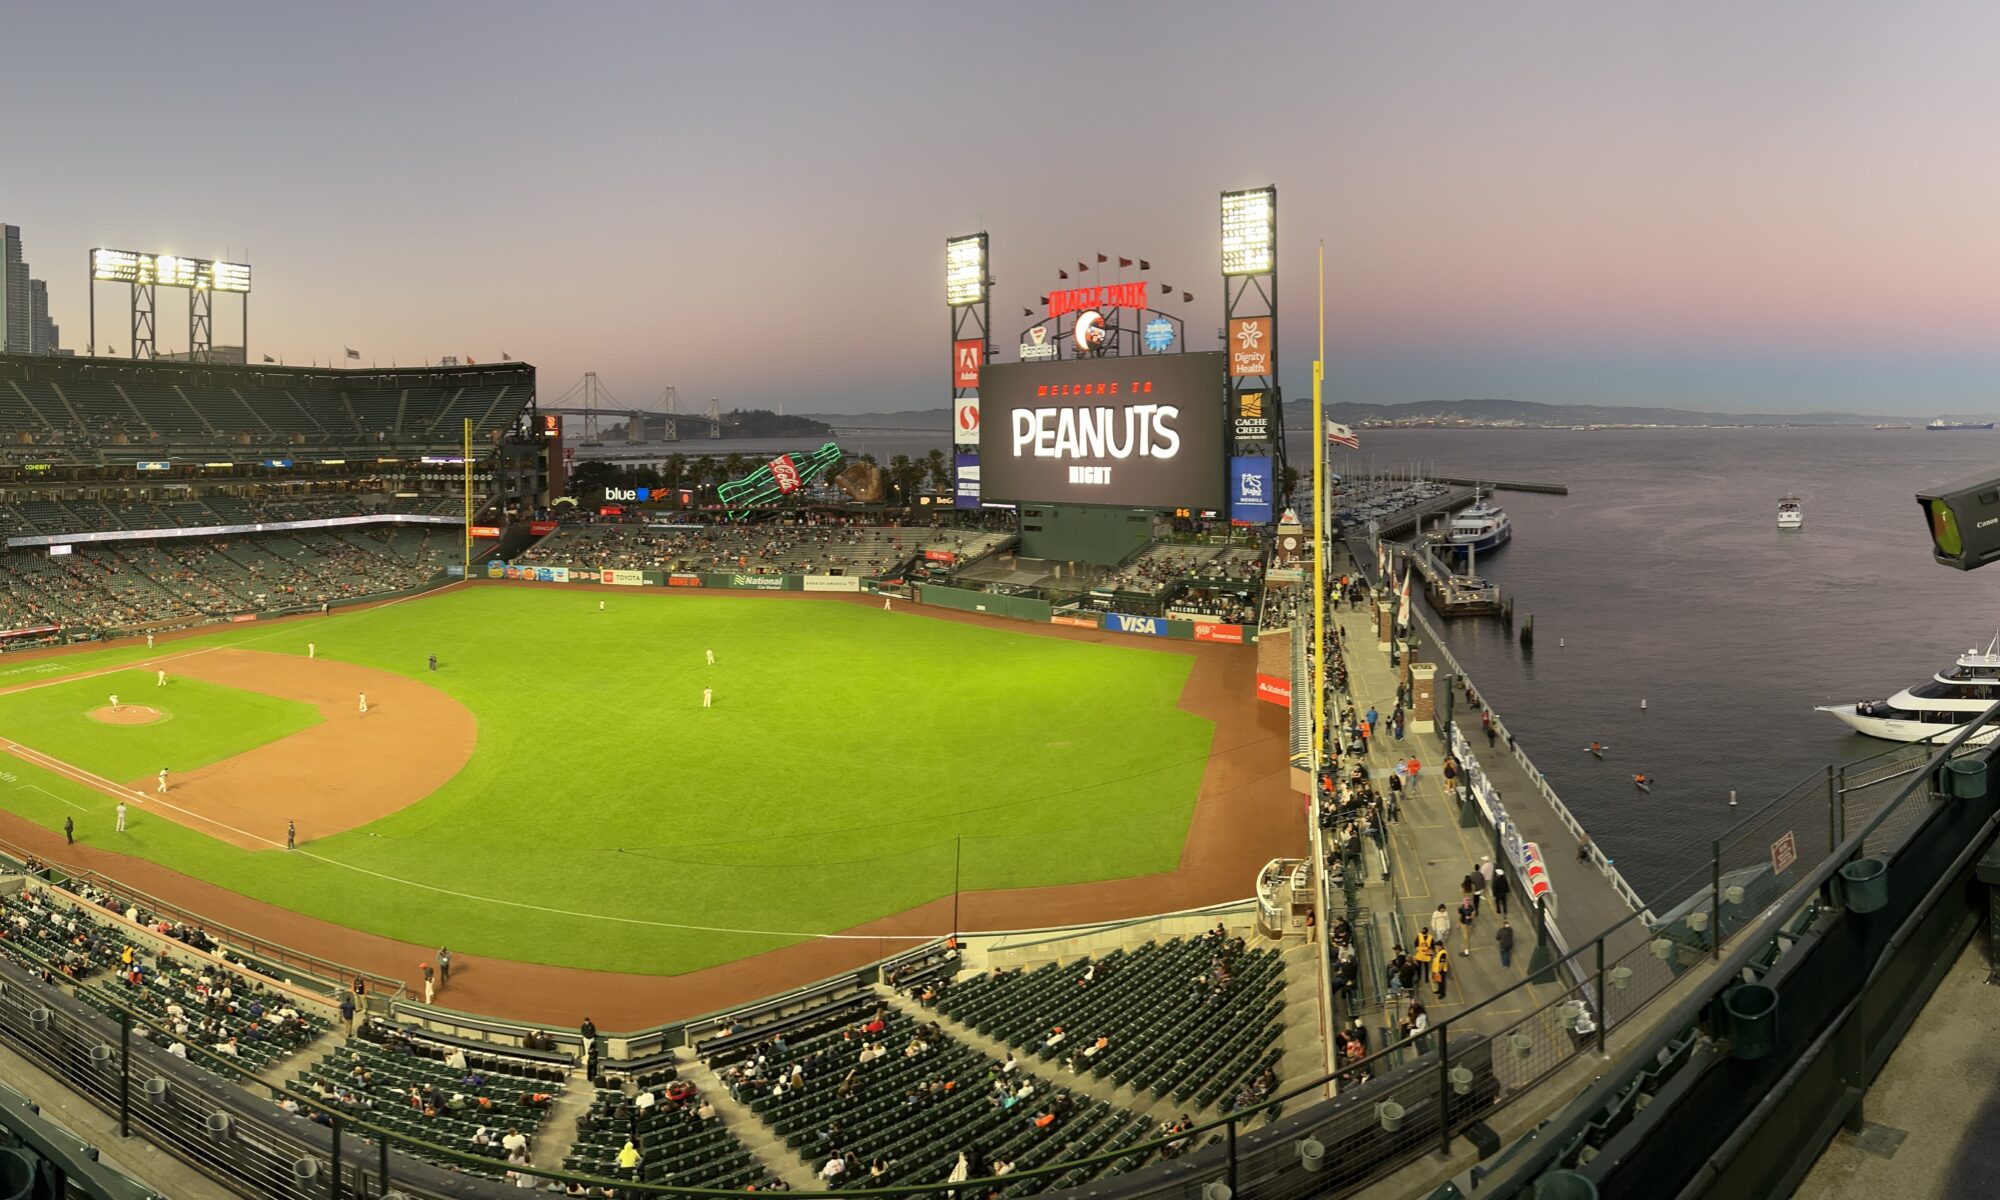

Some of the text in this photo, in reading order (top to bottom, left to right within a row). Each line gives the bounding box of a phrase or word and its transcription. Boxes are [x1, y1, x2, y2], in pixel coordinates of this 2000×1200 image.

[1048, 281, 1148, 318] ORACLE PARK
[1234, 352, 1265, 364] Dignity
[1236, 363, 1265, 373] Health
[1037, 381, 1153, 396] WELCOME TO
[1234, 418, 1268, 426] CACHE
[1011, 404, 1180, 459] PEANUTS
[1235, 426, 1267, 434] CREEK
[1068, 465, 1112, 485] NIGHT
[605, 487, 636, 501] blue
[1976, 517, 1999, 528] Canon
[745, 576, 783, 586] National
[1118, 616, 1156, 634] VISA
